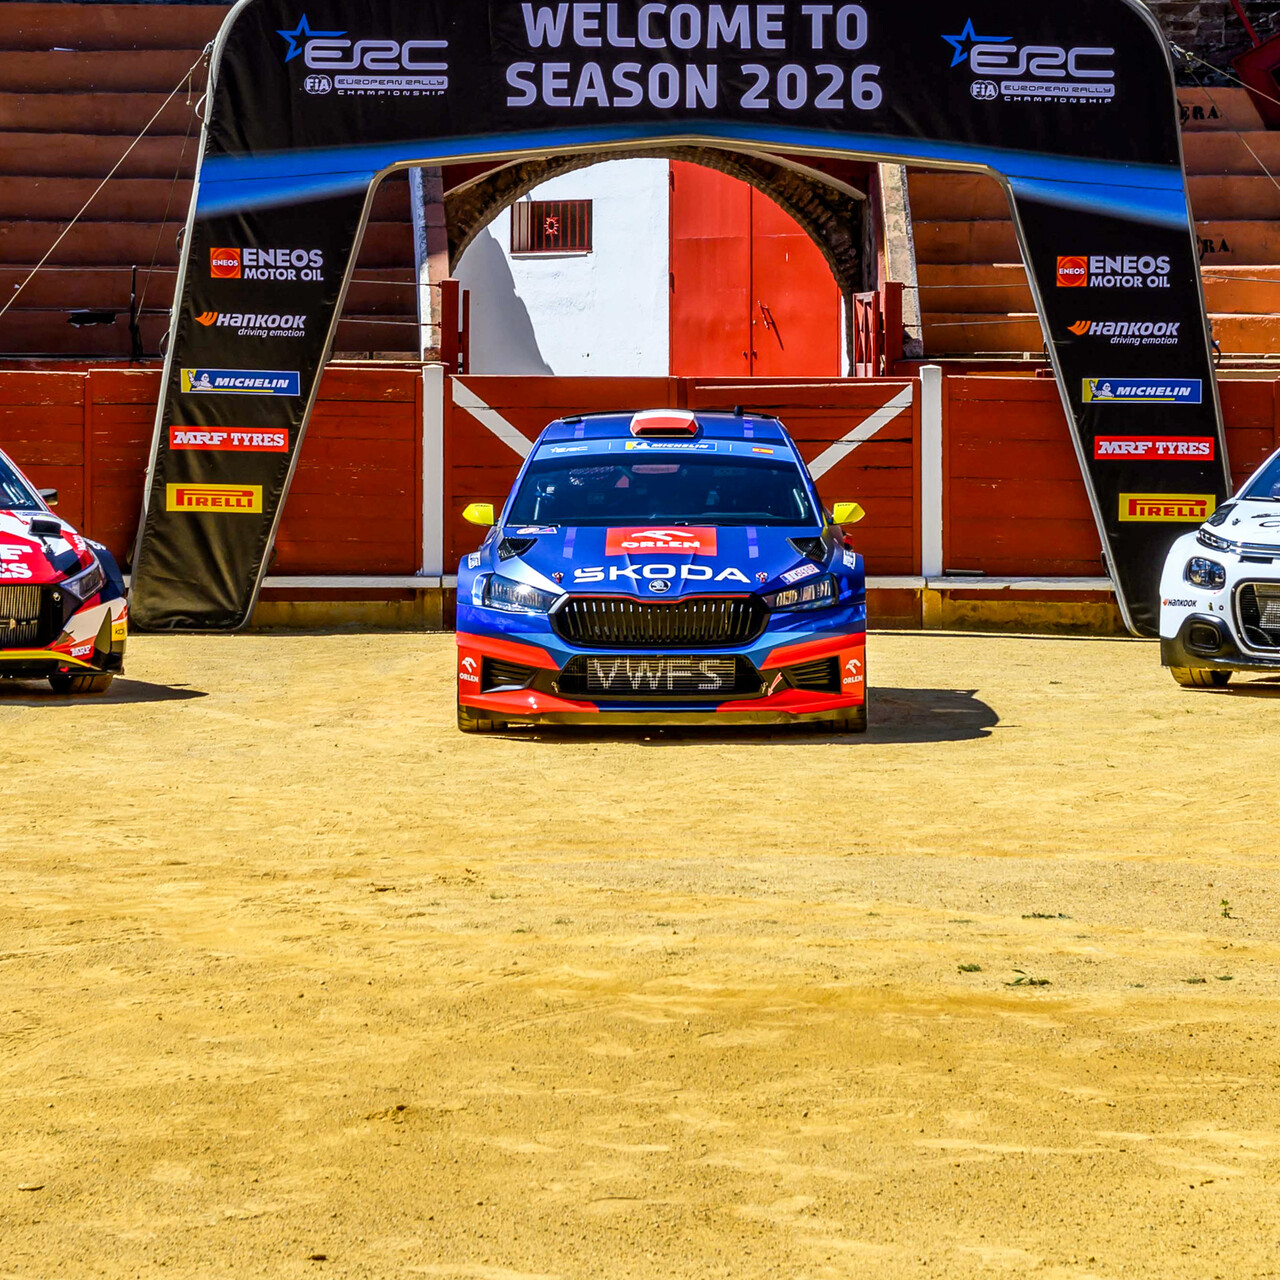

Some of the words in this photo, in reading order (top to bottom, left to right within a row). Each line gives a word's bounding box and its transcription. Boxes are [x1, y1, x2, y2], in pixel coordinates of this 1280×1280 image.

[522, 3, 785, 49] WELCOME
[802, 4, 868, 49] TO
[304, 40, 449, 70] ERC
[970, 44, 1114, 77] ERC
[304, 75, 331, 95] FIA
[336, 77, 402, 88] EUROPEAN
[404, 77, 447, 89] RALLY
[506, 62, 717, 109] SEASON
[740, 64, 883, 110] 2026
[970, 79, 998, 100] FIA
[1003, 84, 1069, 94] EUROPEAN
[1071, 85, 1112, 94] RALLY
[336, 89, 446, 97] CHAMPIONSHIP
[1003, 95, 1112, 104] CHAMPIONSHIP
[212, 259, 239, 267] ENEOS
[243, 248, 324, 267] ENEOS
[1059, 267, 1085, 276] ENEOS
[1090, 256, 1170, 275] ENEOS
[244, 268, 297, 281] MOTOR
[300, 269, 324, 281] OIL
[1090, 275, 1143, 288] MOTOR
[1147, 276, 1170, 288] OIL
[238, 328, 268, 338] driving
[269, 329, 305, 338] emotion
[1110, 335, 1140, 346] driving
[1141, 336, 1178, 345] emotion
[214, 377, 290, 388] MICHELIN
[1116, 386, 1191, 396] MICHELIN
[173, 431, 227, 445] MRF
[230, 433, 285, 447] TYRES
[1098, 441, 1152, 455] MRF
[1156, 442, 1210, 455] TYRES
[176, 489, 255, 508] PIRELLI
[1128, 499, 1208, 518] PIRELLI
[621, 539, 701, 550] ORLEN
[458, 673, 480, 684] ORLEN
[592, 658, 724, 691] VWFS
[842, 674, 864, 686] ORLEN
